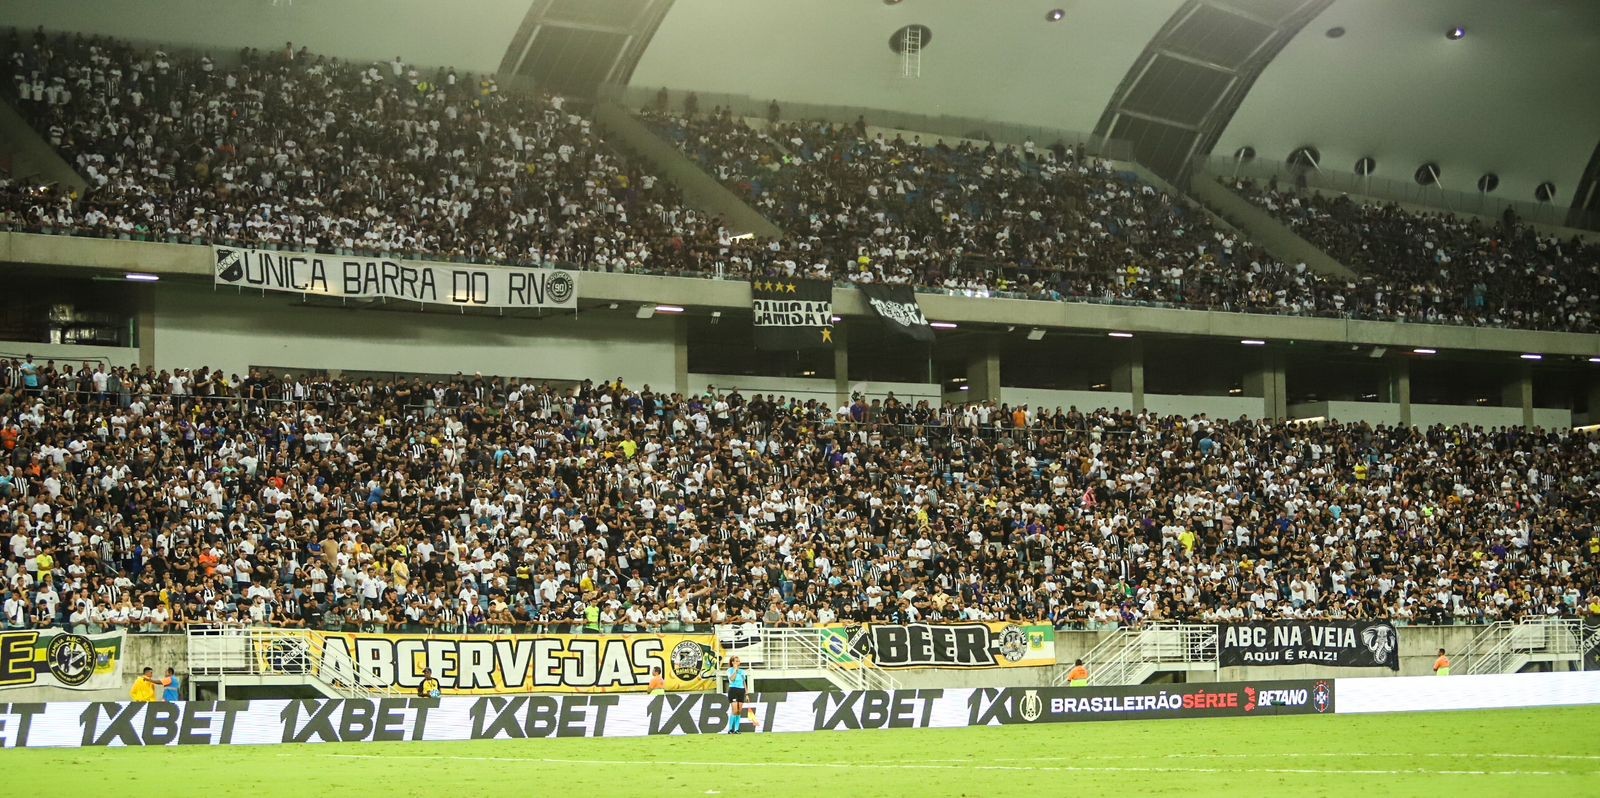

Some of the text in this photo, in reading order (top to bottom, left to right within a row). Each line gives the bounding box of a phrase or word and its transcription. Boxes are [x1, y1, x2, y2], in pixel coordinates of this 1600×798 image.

[343, 262, 437, 300] BARRA
[452, 271, 488, 305] DO
[508, 271, 545, 304] RN
[754, 301, 816, 325] CAMISA
[873, 624, 997, 665] BEER
[1225, 626, 1266, 648] ABC
[1273, 626, 1302, 647] NA
[1310, 625, 1357, 648] VEIA
[1244, 649, 1338, 662] AQUI É RAIZ!
[319, 636, 665, 689] ABCERVEJAS
[469, 695, 621, 739] 1XBET
[812, 688, 944, 730] 1XBET
[1050, 689, 1238, 713] BRASILEIRÃO SÉRIE
[1258, 689, 1308, 706] BETANO
[80, 701, 250, 746] 1XBET
[279, 697, 443, 744] 1XBET
